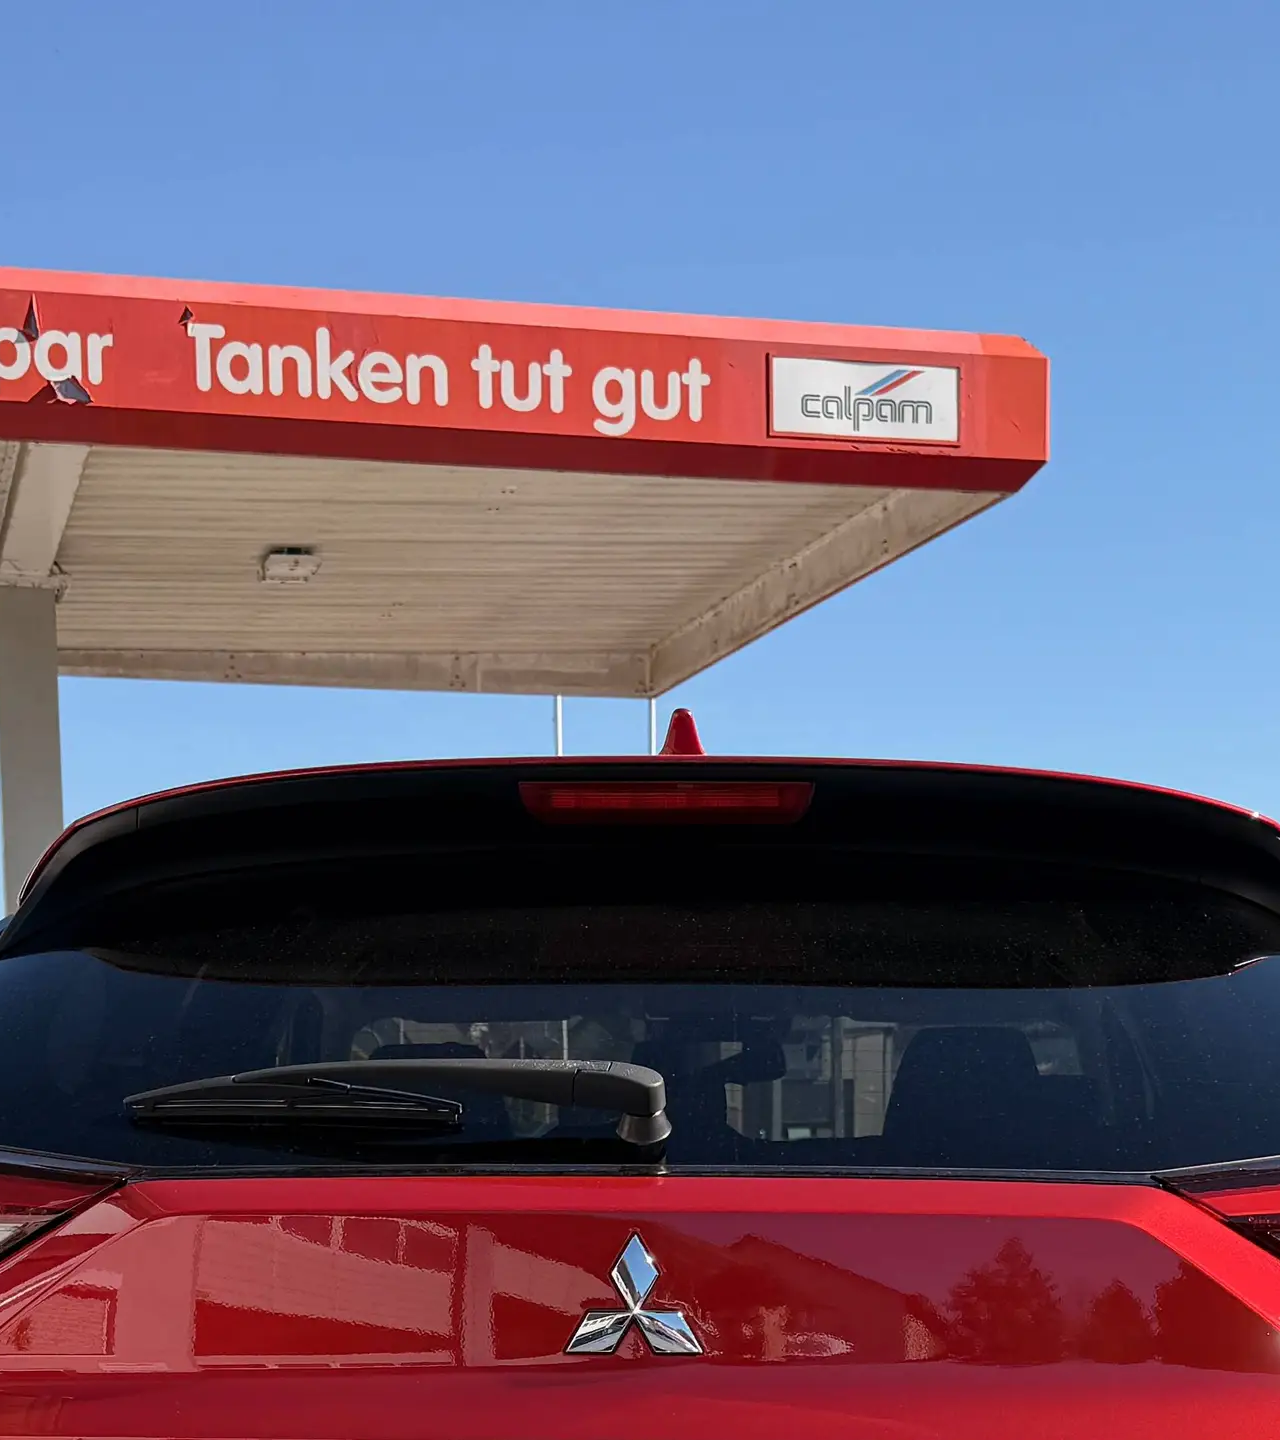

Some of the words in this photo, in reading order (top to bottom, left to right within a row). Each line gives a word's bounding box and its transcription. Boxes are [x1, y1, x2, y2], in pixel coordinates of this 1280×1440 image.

[187, 322, 449, 406] Tanken
[470, 344, 573, 414] tut
[592, 357, 711, 437] gut
[800, 385, 933, 432] calpam
